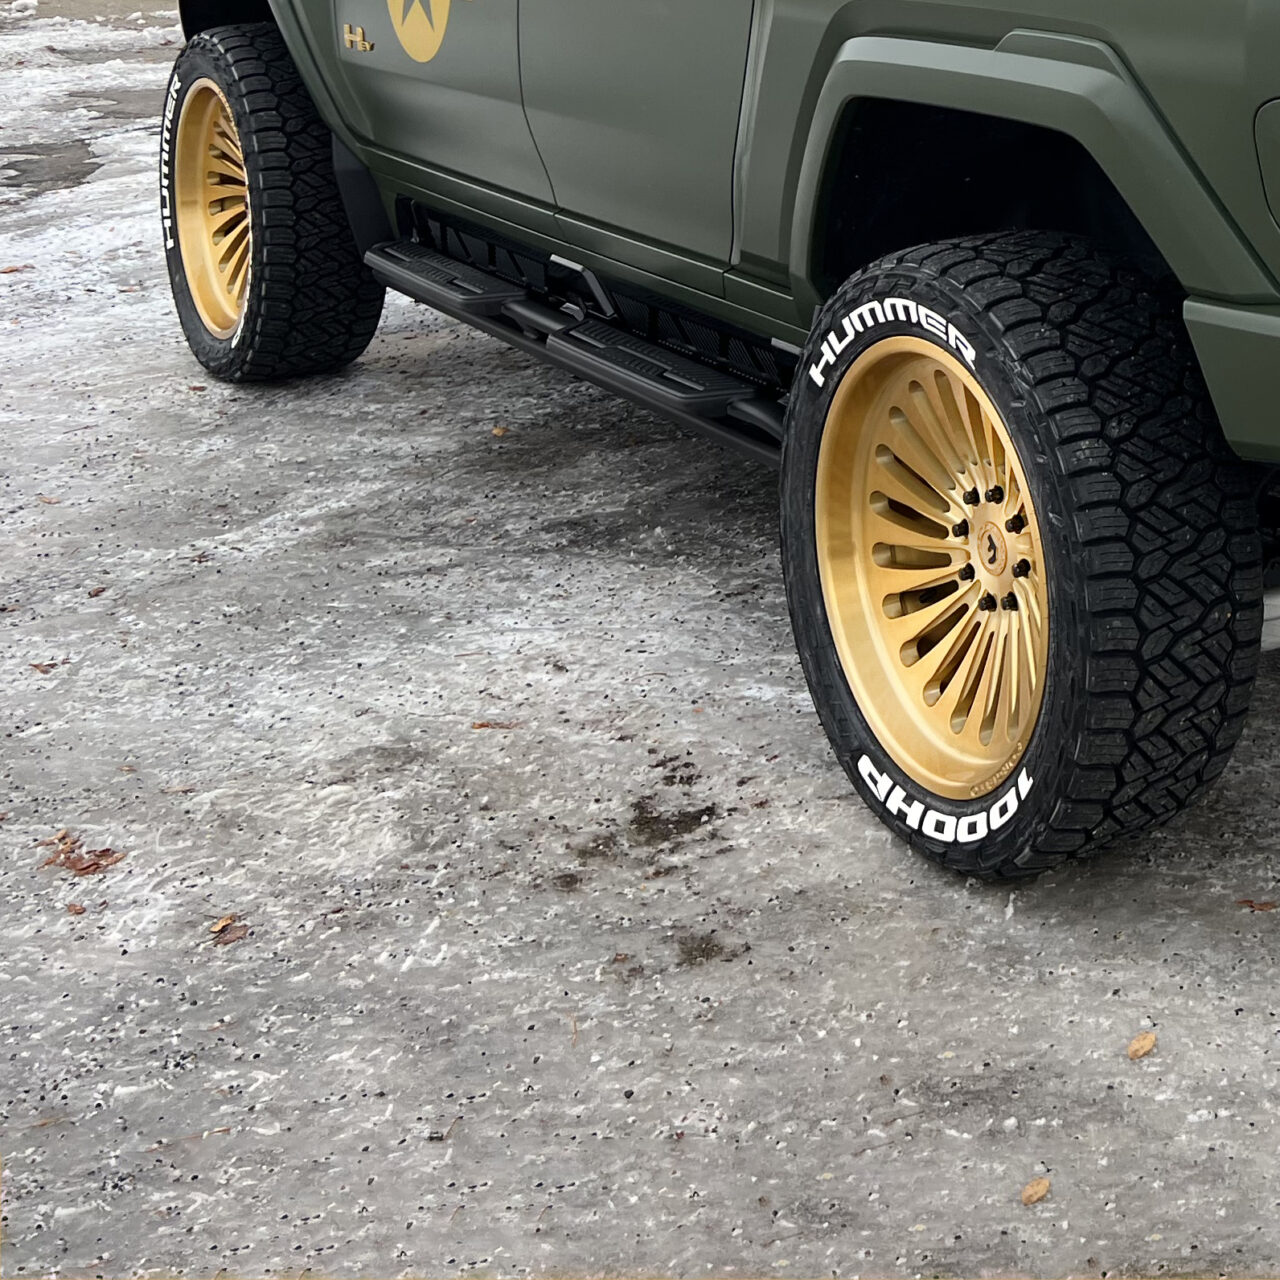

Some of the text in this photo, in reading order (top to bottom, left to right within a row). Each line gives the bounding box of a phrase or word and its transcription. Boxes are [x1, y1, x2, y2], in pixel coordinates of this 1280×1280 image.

[161, 73, 182, 250] HUMMER
[808, 297, 976, 388] HUMMER
[857, 754, 1034, 843] 1000HP
